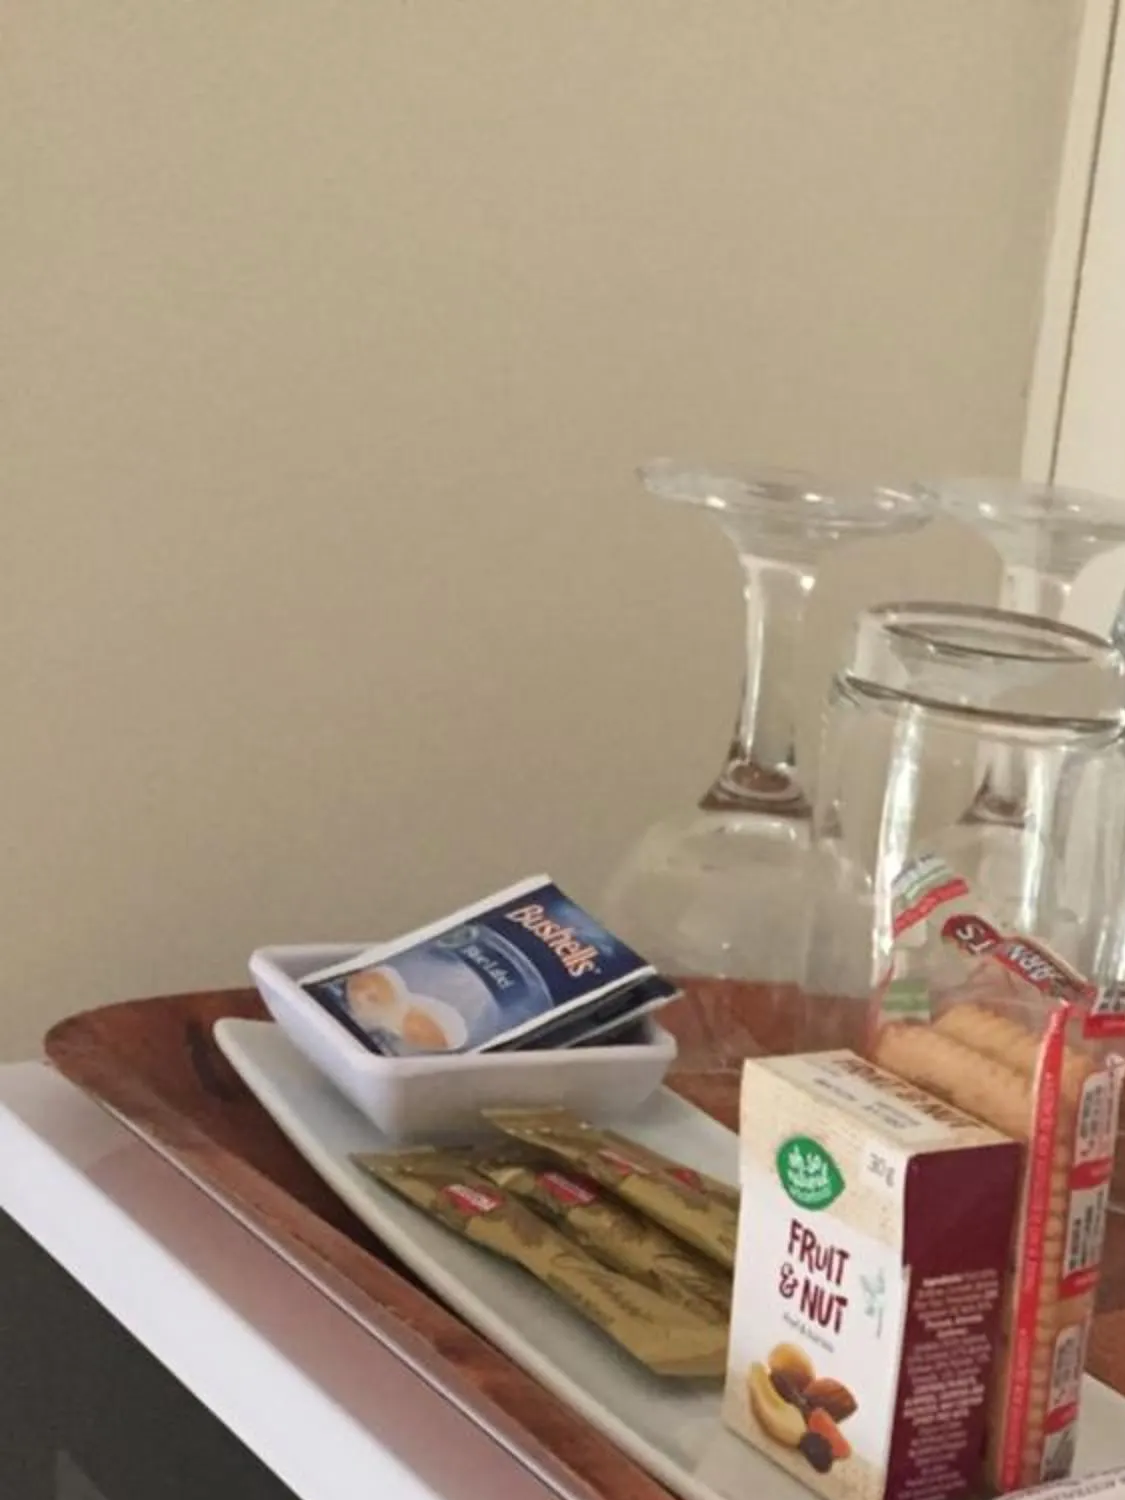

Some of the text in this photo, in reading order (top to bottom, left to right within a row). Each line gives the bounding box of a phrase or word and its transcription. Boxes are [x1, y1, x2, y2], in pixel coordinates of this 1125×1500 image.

[506, 904, 597, 978] Bushells
[779, 1263, 799, 1299] &
[801, 1278, 849, 1334] NUT
